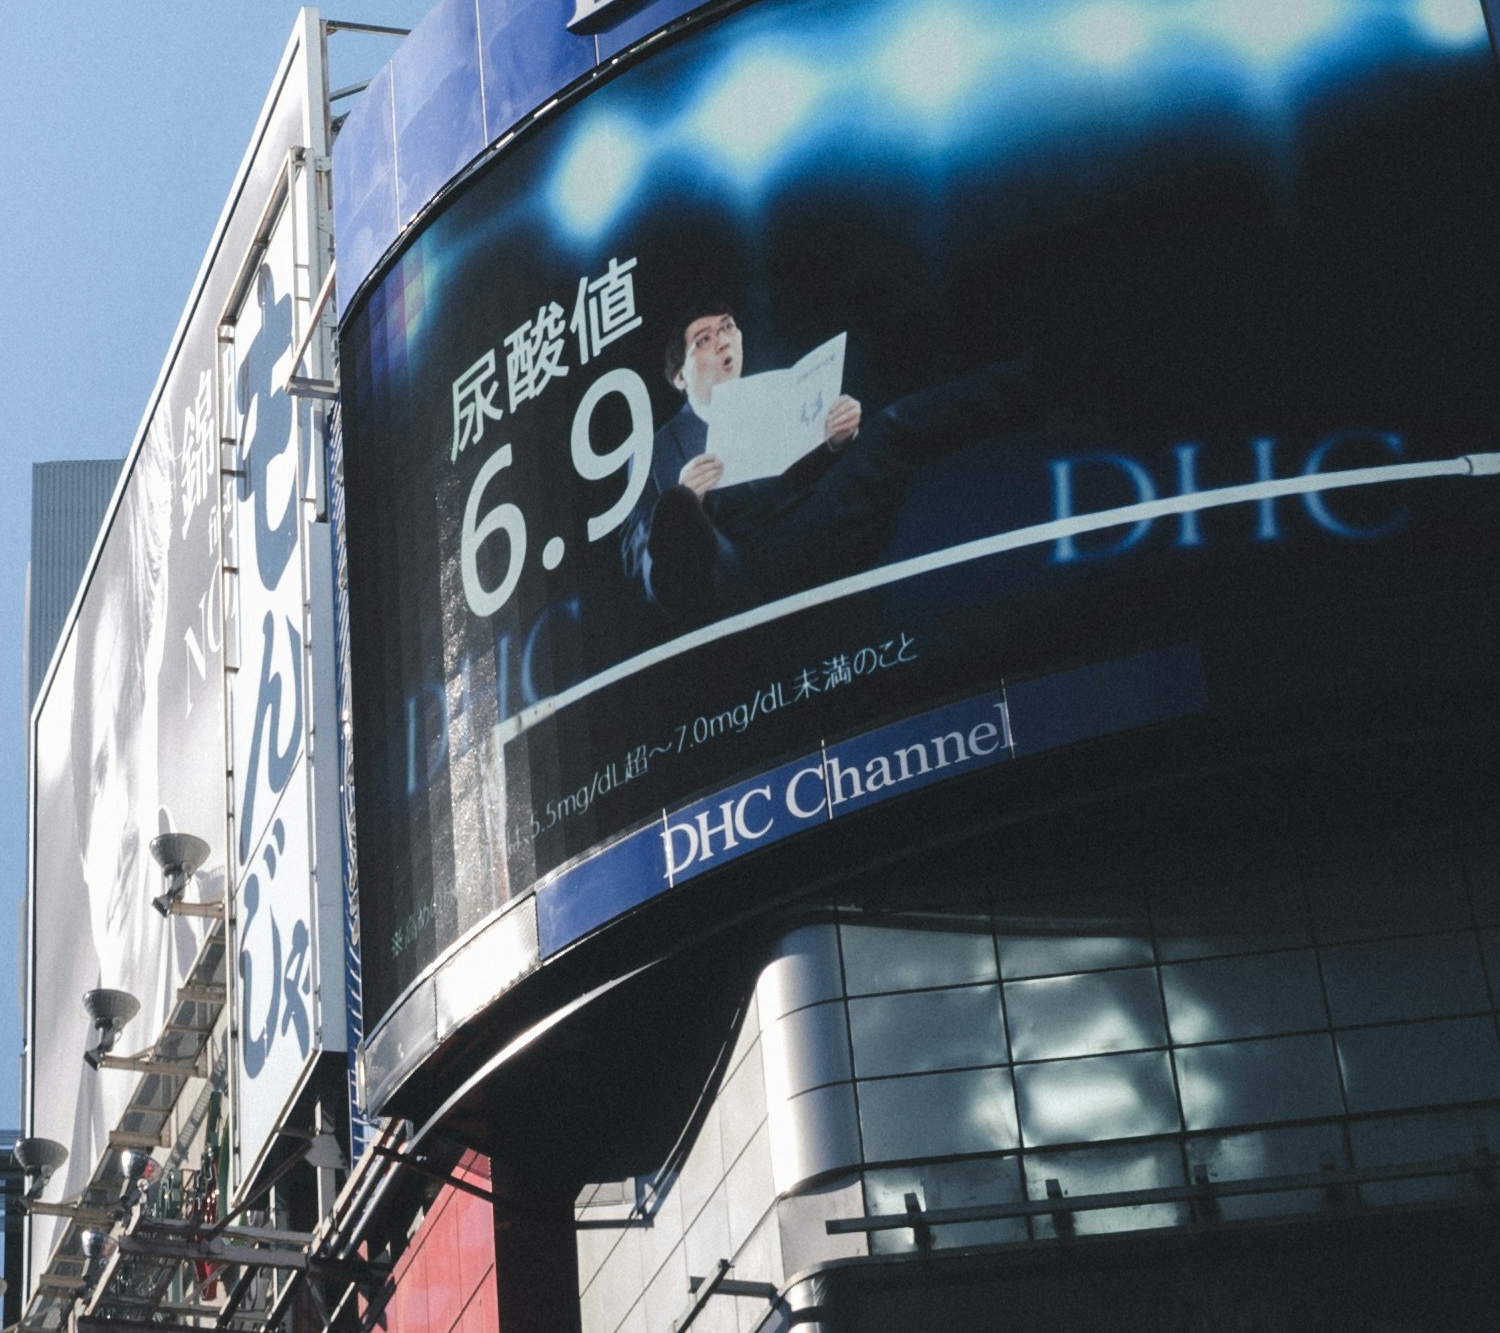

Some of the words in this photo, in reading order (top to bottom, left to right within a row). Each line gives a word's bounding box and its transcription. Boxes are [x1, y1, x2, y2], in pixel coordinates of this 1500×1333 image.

[450, 257, 642, 461] 尿酸値
[461, 367, 655, 618] 6.9
[1051, 431, 1404, 566] DHC
[660, 784, 775, 879] DHC
[785, 695, 1016, 819] Channel
